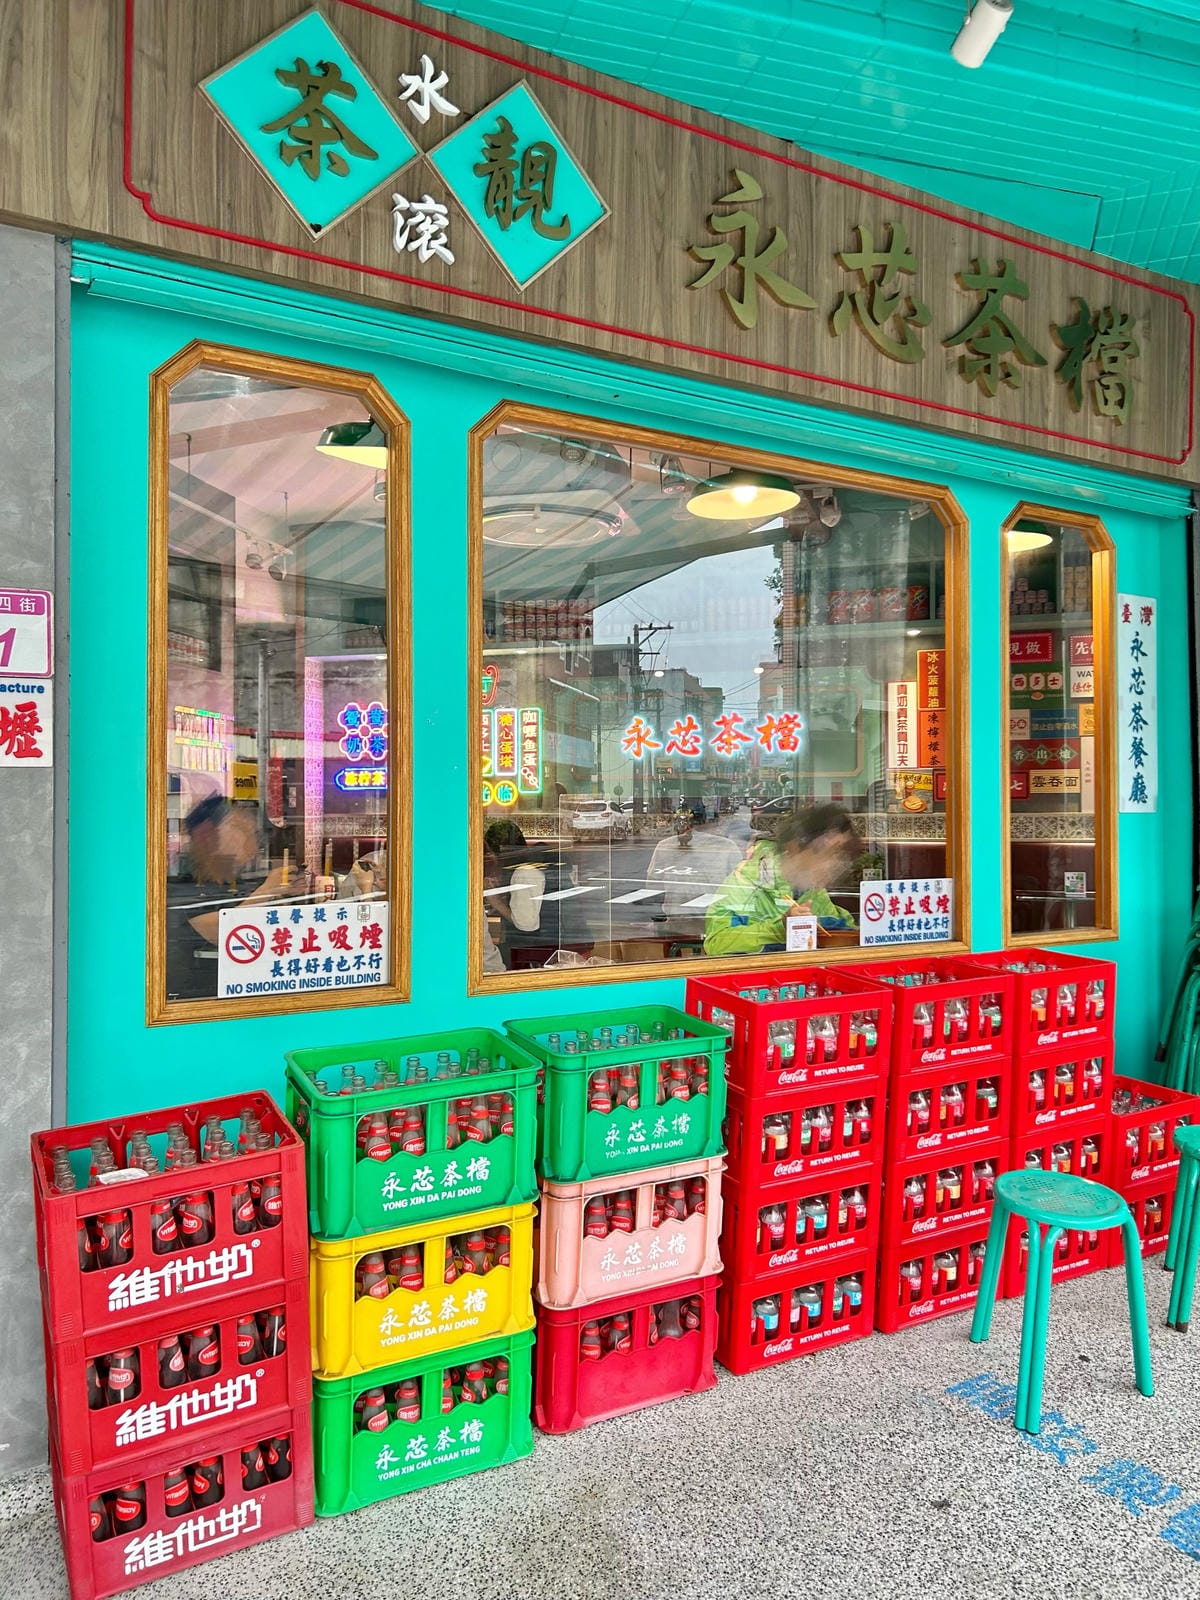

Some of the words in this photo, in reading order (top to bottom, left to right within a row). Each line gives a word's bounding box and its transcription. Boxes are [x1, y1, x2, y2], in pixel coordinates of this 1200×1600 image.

[398, 54, 460, 124] 水
[259, 56, 379, 181] 茶
[473, 116, 572, 241] 靚
[685, 168, 1141, 427] 永芯茶檔
[1121, 604, 1154, 626] 臺灣
[1013, 676, 1060, 687] 西多士
[1128, 631, 1149, 804] 永芯茶餐廳
[621, 711, 803, 758] 永芯茶檔
[888, 894, 949, 917] 禁止吸煙
[270, 922, 383, 956] 禁止吸煙
[864, 935, 874, 944] NO
[874, 934, 902, 944] SMOKING
[903, 932, 922, 942] INSIDE
[923, 931, 949, 940] BUILDING
[270, 953, 383, 978] 長得好看也不行
[226, 983, 243, 995] NO
[246, 979, 296, 993] SMOKING
[299, 976, 333, 989] INSIDE
[334, 972, 381, 986] BUILDING
[1062, 1030, 1078, 1038] RETURN
[1083, 1027, 1097, 1035] REUSE
[950, 1047, 970, 1055] RETURN
[976, 1044, 992, 1052] REUSE
[814, 1066, 837, 1077] RETURN
[837, 1065, 844, 1073] TO
[845, 1063, 864, 1072] REUSE
[1060, 1108, 1076, 1116] RETURN
[1081, 1103, 1095, 1112] REUSE
[604, 1113, 691, 1148] 永芯茶檔
[947, 1131, 966, 1139] RETURN
[973, 1126, 989, 1134] REUSE
[626, 1146, 639, 1155] XIN
[640, 1144, 650, 1153] DA
[651, 1141, 663, 1151] PAI
[810, 1156, 833, 1167] RETURN
[833, 1154, 840, 1162] TO
[840, 1150, 860, 1161] REUSE
[380, 1156, 491, 1199] 永芯茶檔
[1153, 1164, 1168, 1172] RETURN
[382, 1199, 408, 1211] YONG
[410, 1195, 426, 1206] XIN
[427, 1193, 440, 1203] DA
[441, 1189, 456, 1200] PAI
[457, 1185, 482, 1197] DONG
[942, 1213, 962, 1224] RETURN
[969, 1208, 985, 1217] REUSE
[600, 1232, 688, 1271] 永芯茶檔
[805, 1245, 829, 1256] RETURN
[829, 1242, 837, 1250] TO
[836, 1237, 855, 1248] REUSE
[1148, 1237, 1163, 1245] RETURN
[601, 1270, 622, 1282] YONG
[660, 1259, 679, 1270] DONG
[1052, 1263, 1070, 1273] RETURN
[1076, 1259, 1089, 1268] REUSE
[379, 1287, 488, 1335] 永芯茶檔
[939, 1295, 959, 1306] RETURN
[380, 1334, 406, 1348] YONG
[407, 1330, 423, 1341] XIN
[424, 1327, 437, 1338] DA
[438, 1323, 452, 1335] PAI
[454, 1317, 479, 1331] DONG
[799, 1333, 823, 1344] RETURN
[823, 1330, 831, 1338] TO
[831, 1324, 850, 1335] REUSE
[374, 1418, 485, 1471] 永芯茶檔
[378, 1469, 400, 1481] YONG
[401, 1465, 415, 1476] XIN
[416, 1460, 432, 1472] CHA
[433, 1453, 459, 1467] CHAAN
[460, 1446, 481, 1460] TENG
